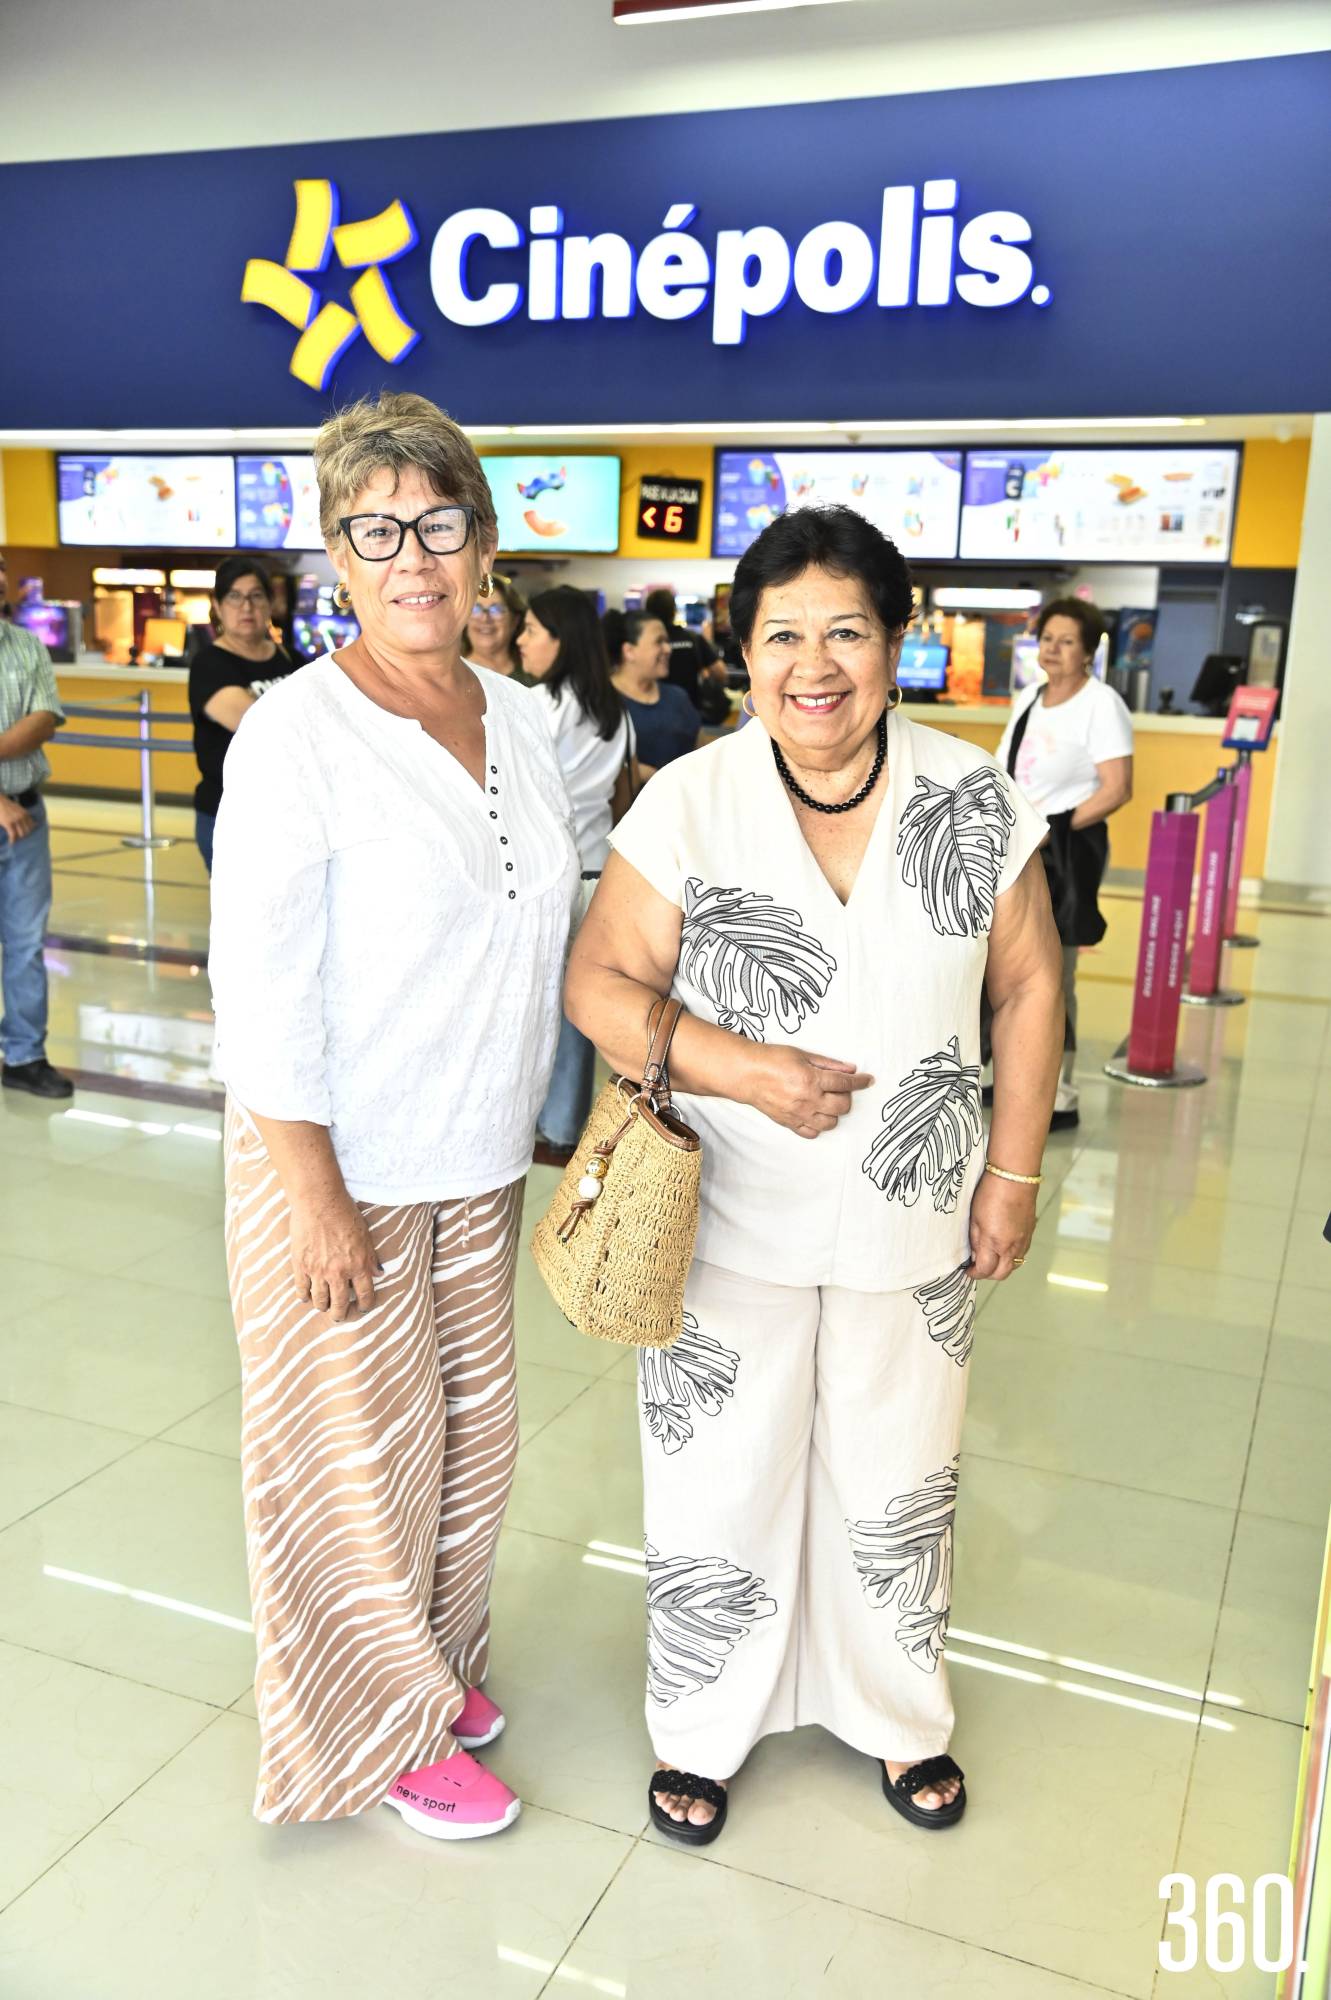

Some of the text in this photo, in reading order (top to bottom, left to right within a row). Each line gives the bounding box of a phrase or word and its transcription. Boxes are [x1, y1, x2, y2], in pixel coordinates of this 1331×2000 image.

[664, 505, 683, 533] 6
[396, 1785, 455, 1812] new sport
